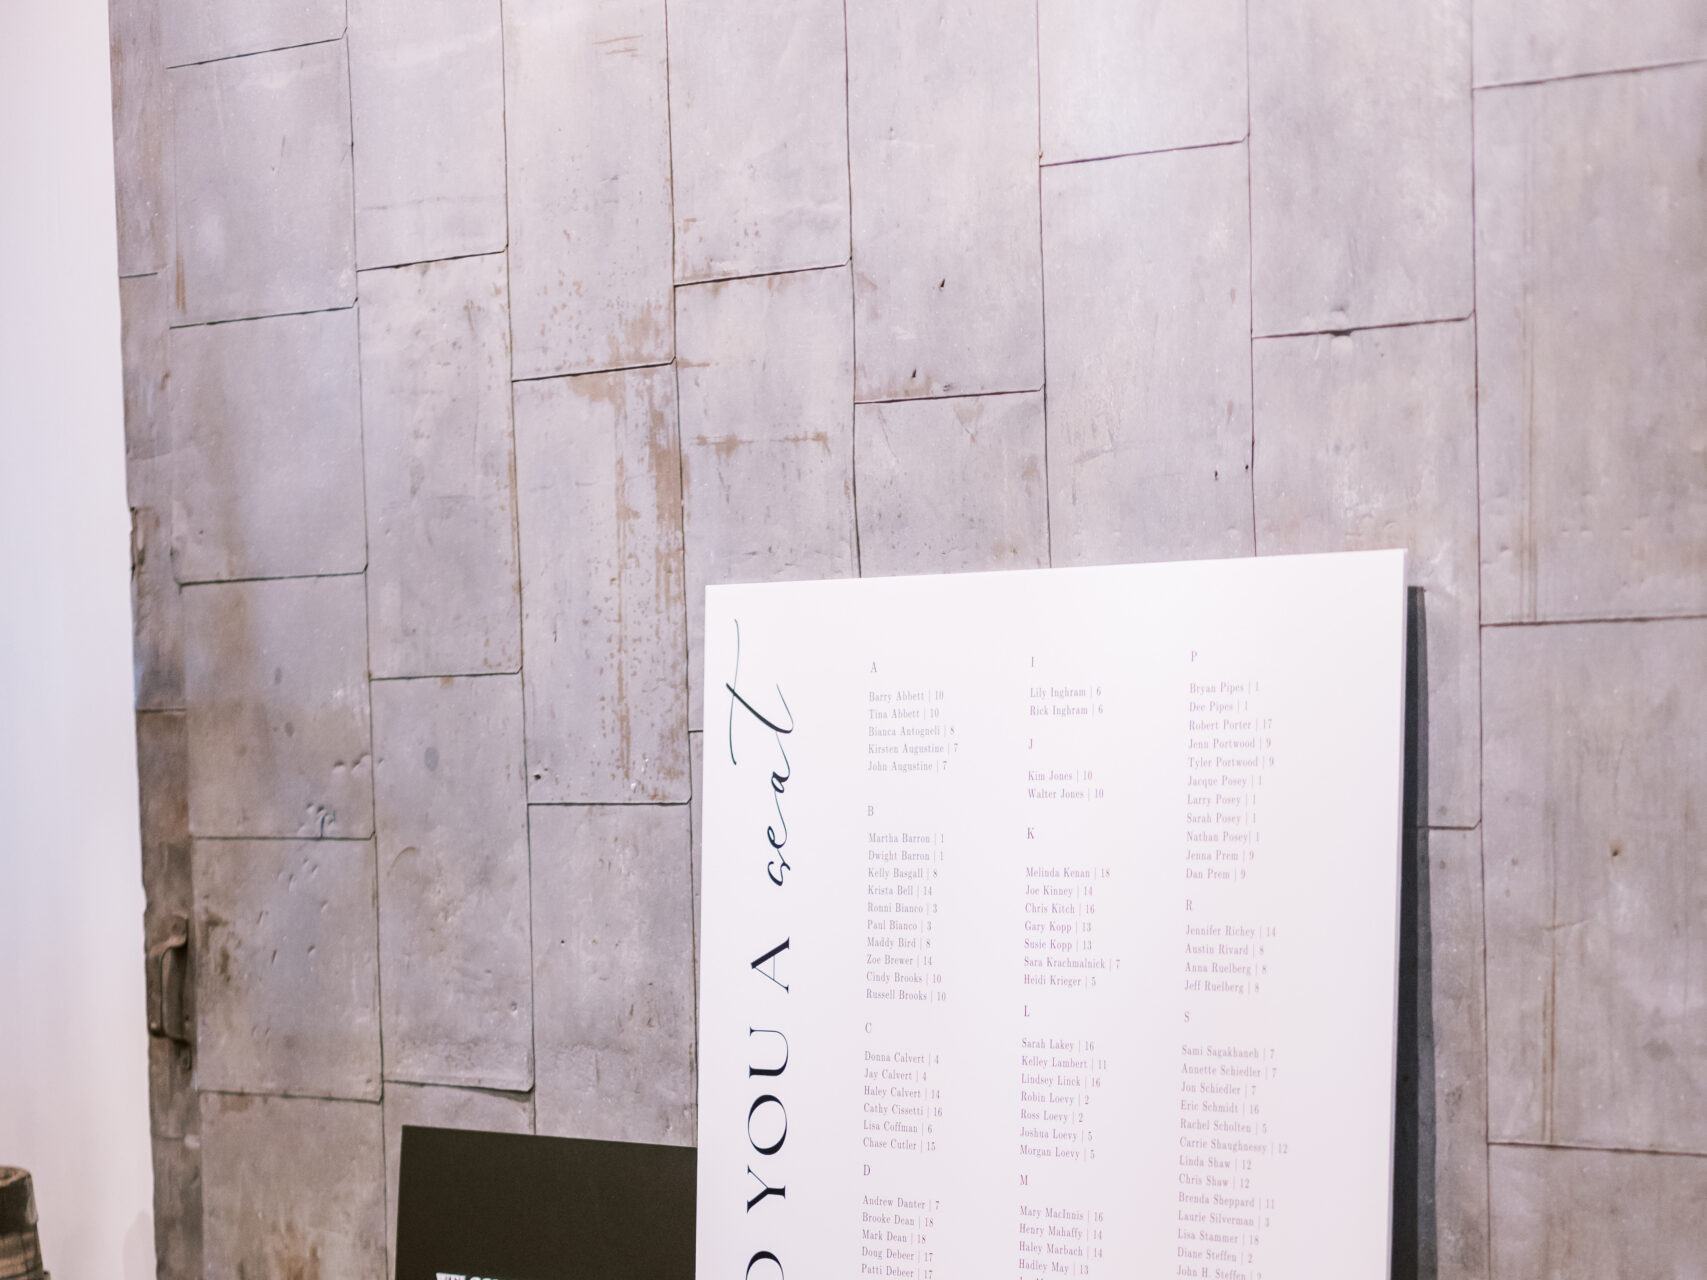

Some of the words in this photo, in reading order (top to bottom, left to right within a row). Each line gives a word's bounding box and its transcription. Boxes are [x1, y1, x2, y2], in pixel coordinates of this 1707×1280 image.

[1190, 649, 1198, 663] P
[870, 661, 878, 674] A
[869, 691, 893, 704] Barry
[896, 690, 924, 704] Abbett
[935, 690, 944, 701] 10
[1029, 704, 1049, 716] Rick
[1052, 704, 1088, 720] Inghram
[1189, 719, 1219, 732] Robert
[1223, 718, 1252, 731] Porter
[1263, 718, 1272, 730] 17
[726, 619, 794, 887] seat
[1028, 770, 1046, 783] Kim
[1048, 769, 1073, 782] Jones
[1083, 770, 1093, 782] 10
[867, 805, 874, 817] B
[1027, 827, 1035, 839] K
[867, 884, 894, 896] Krista
[897, 884, 914, 896] Bell
[923, 886, 932, 896] 14
[1024, 902, 1049, 914] Chris
[1051, 902, 1075, 915] Kitch
[1086, 904, 1095, 915] 16
[1185, 898, 1193, 911] R
[1185, 923, 1222, 936] Jennifer
[1225, 924, 1256, 940] Richey
[1266, 926, 1276, 937] 14
[1024, 938, 1047, 951] Susie
[1050, 938, 1073, 953] Kopp
[1083, 939, 1092, 951] 13
[750, 937, 790, 990] A
[866, 953, 881, 965] Zoe
[884, 954, 914, 966] Brewer
[923, 955, 932, 967] 14
[866, 988, 896, 1000] Russell
[898, 989, 927, 1001] Brooks
[937, 991, 947, 1002] 10
[1023, 1004, 1030, 1018] L
[1183, 1010, 1190, 1023] S
[864, 1021, 872, 1034] C
[1021, 1055, 1049, 1070] Kelley
[1051, 1056, 1088, 1069] Lambert
[1098, 1059, 1107, 1070] 11
[864, 1085, 887, 1099] Haley
[890, 1086, 921, 1099] Calvert
[931, 1089, 940, 1100] 14
[863, 1102, 889, 1116] Cathy
[891, 1103, 924, 1116] Cissetti
[933, 1106, 943, 1117] 16
[1180, 1099, 1199, 1112] Eric
[1202, 1100, 1239, 1114] Schmidt
[1249, 1104, 1260, 1115] 16
[745, 1027, 789, 1214] YOU
[862, 1136, 888, 1149] Chase
[890, 1138, 917, 1151] Cutler
[927, 1141, 936, 1152] 15
[1179, 1154, 1205, 1168] Linda
[1207, 1156, 1231, 1169] Shaw
[1242, 1159, 1252, 1171] 12
[1020, 1174, 1028, 1186] M
[862, 1211, 891, 1224] Brooke
[894, 1214, 915, 1226] Dean
[925, 1217, 934, 1228] 18
[1019, 1205, 1042, 1220] Mary
[1045, 1207, 1084, 1221] MacInnis
[1094, 1211, 1104, 1223] 16
[1177, 1227, 1197, 1240] Lisa
[1199, 1229, 1239, 1244] Stammer
[1249, 1233, 1260, 1246] 18
[1019, 1240, 1043, 1256] Haley
[1046, 1242, 1083, 1257] Marbach
[1094, 1247, 1103, 1259] 14
